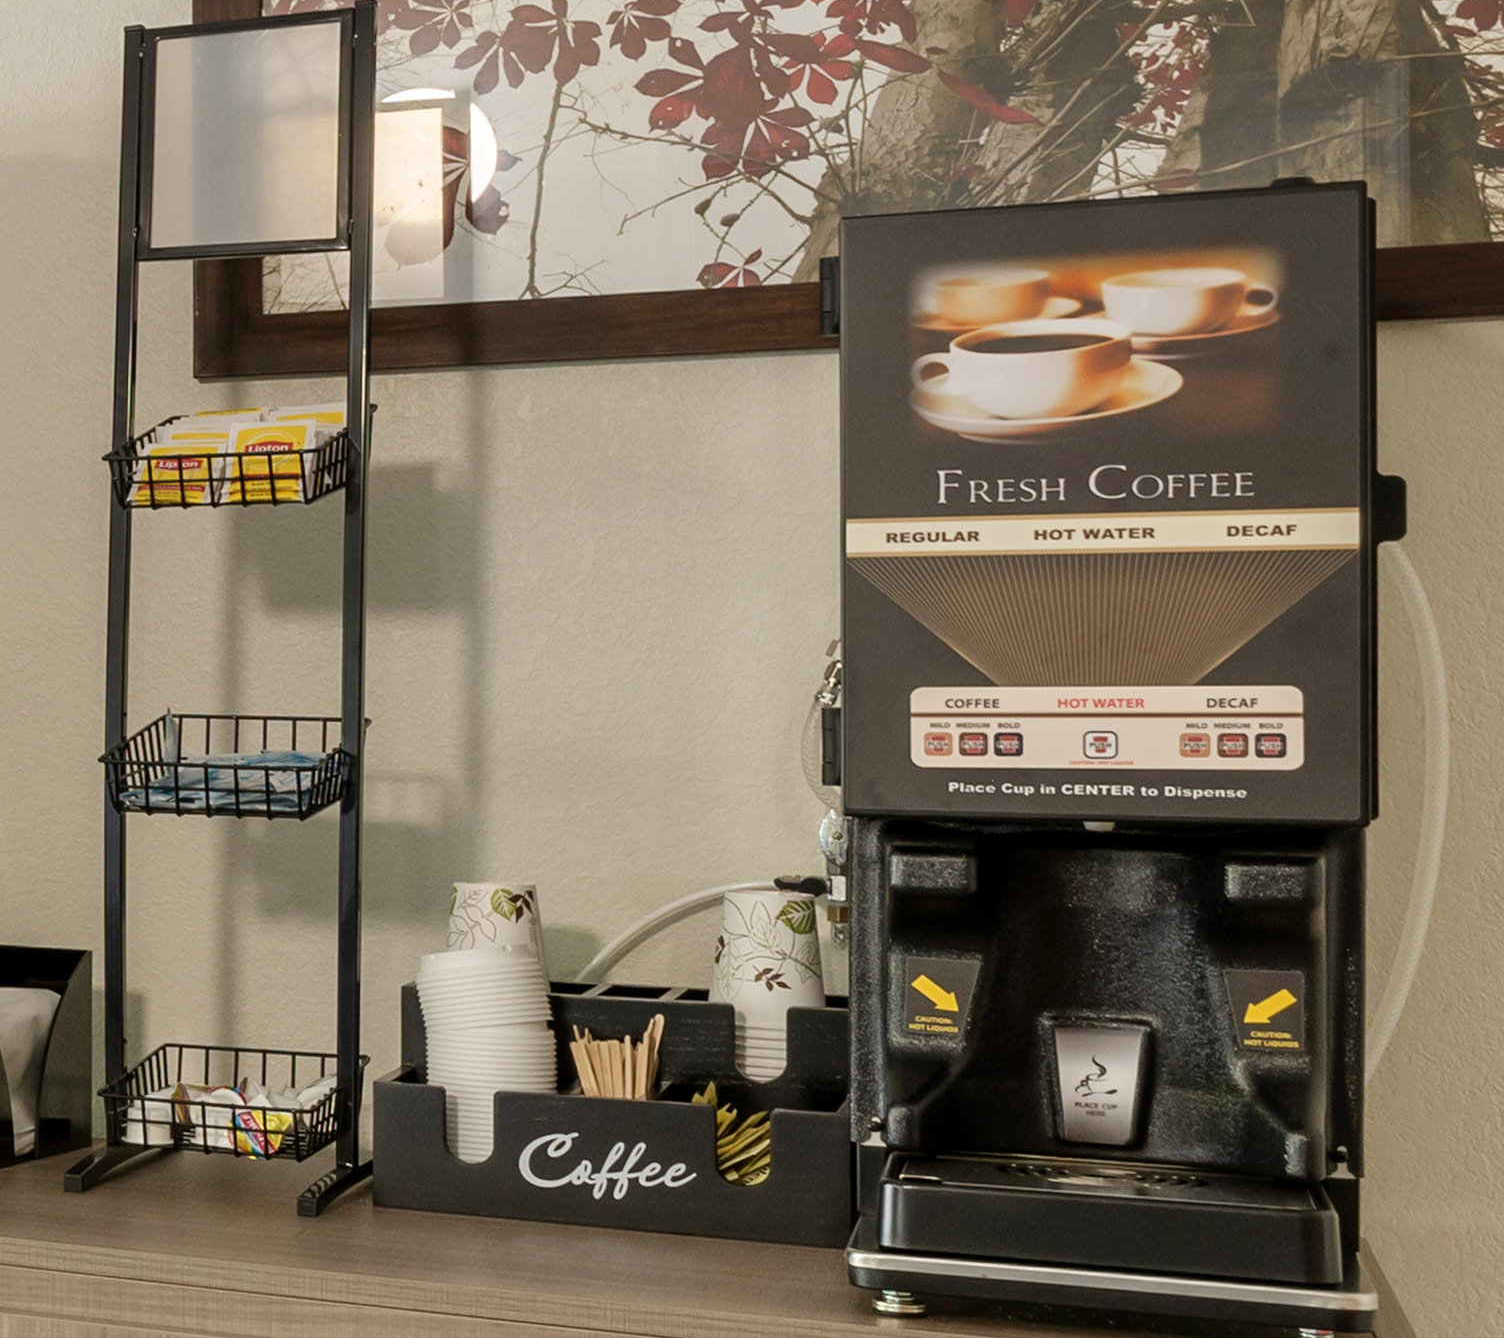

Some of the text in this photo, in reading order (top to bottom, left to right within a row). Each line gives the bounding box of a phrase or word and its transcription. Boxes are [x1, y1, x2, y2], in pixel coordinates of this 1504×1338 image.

[247, 443, 290, 454] Lipton
[159, 461, 199, 469] Lipon
[936, 464, 1256, 504] FRESH COFFEE
[1034, 527, 1155, 542] HOT WATER
[1226, 524, 1298, 538] DECAF
[886, 531, 980, 544] REGULAR
[945, 698, 1000, 709] COFFEE
[1057, 698, 1145, 709] HOT WATER
[1206, 697, 1258, 709] DECAF
[948, 782, 1247, 800] Place Cup in CENTER to Dispense
[926, 1024, 958, 1032] LIQUIDS
[1264, 1040, 1299, 1048] LIQUIDS
[518, 1132, 697, 1201] Coffee
